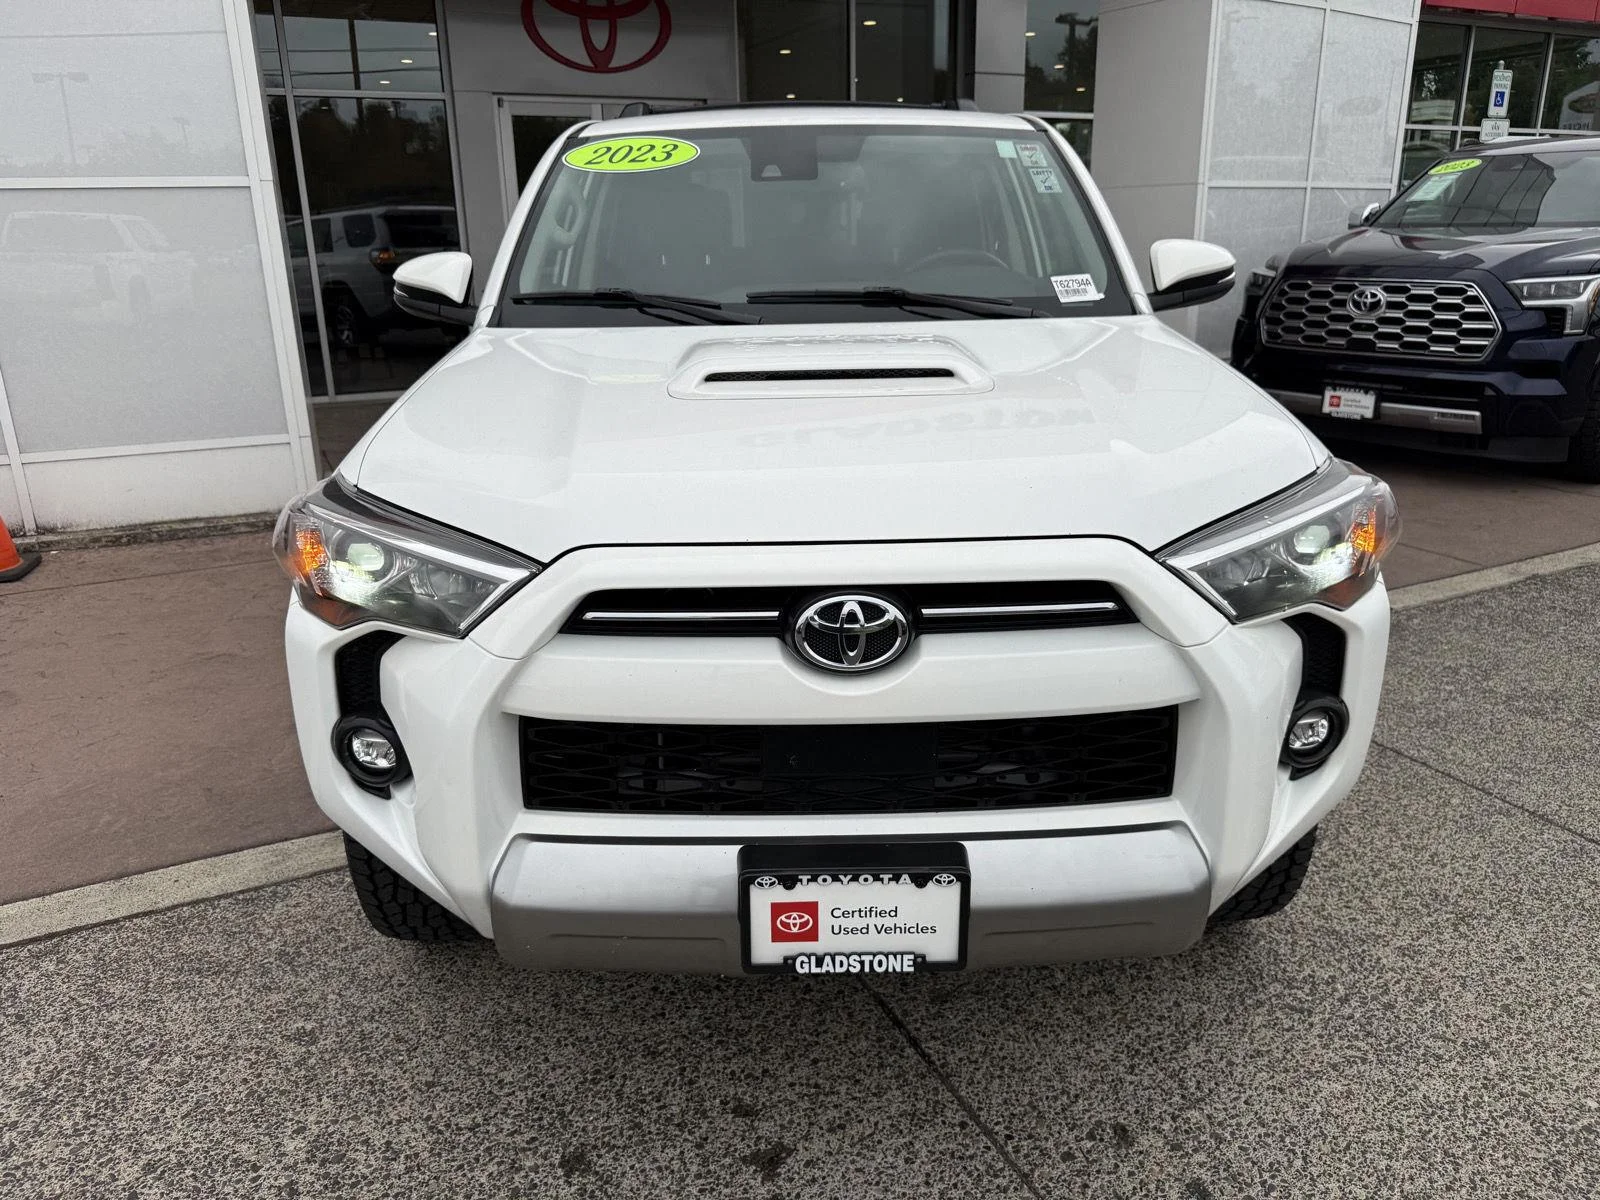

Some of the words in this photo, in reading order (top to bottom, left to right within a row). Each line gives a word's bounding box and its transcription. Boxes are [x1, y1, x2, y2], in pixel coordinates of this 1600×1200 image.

[584, 144, 679, 166] 2023
[1053, 279, 1092, 289] T62794A
[798, 874, 913, 886] TOYOTA
[830, 906, 898, 919] Certified
[831, 923, 870, 936] Used
[873, 922, 937, 936] Vehicles
[795, 954, 915, 974] GLADSTONE
